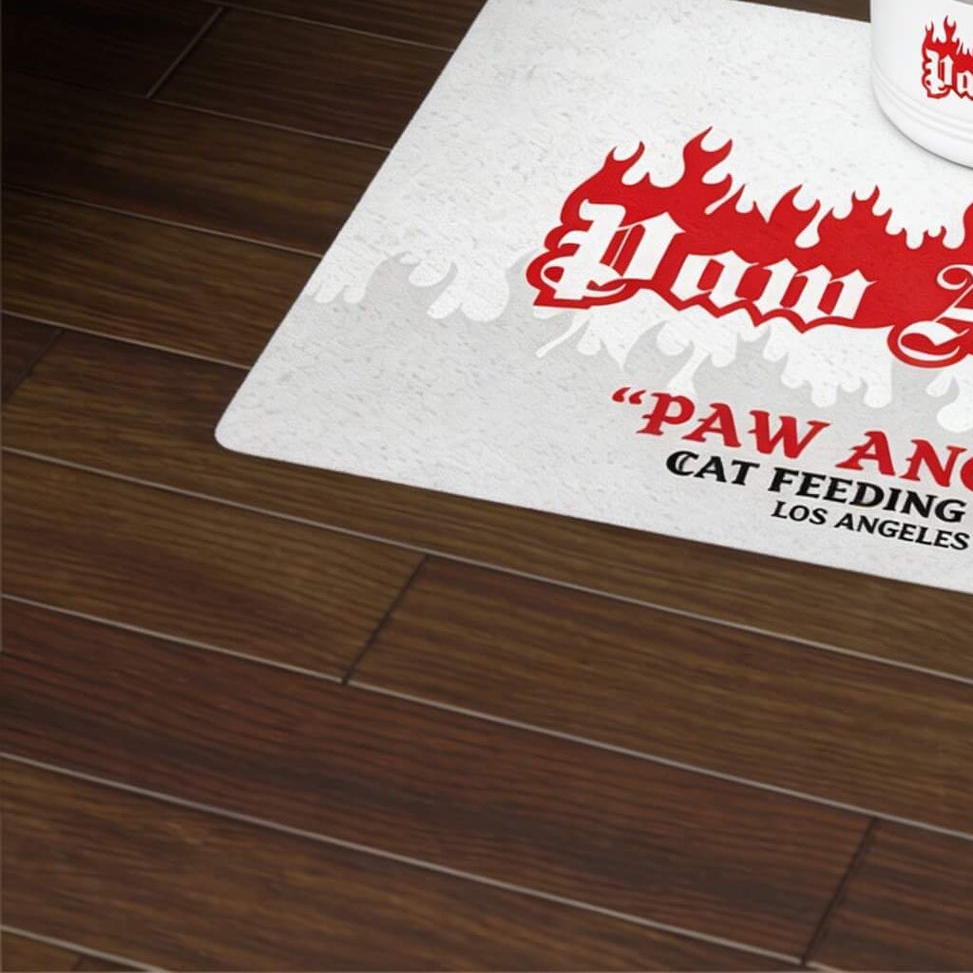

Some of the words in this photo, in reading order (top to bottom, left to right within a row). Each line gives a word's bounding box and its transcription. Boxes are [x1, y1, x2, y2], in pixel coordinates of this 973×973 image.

[543, 202, 875, 323] Paw
[666, 451, 760, 486] CAT
[767, 467, 967, 523] FEEDING
[771, 500, 828, 525] LOS
[833, 512, 970, 551] ANGELES
